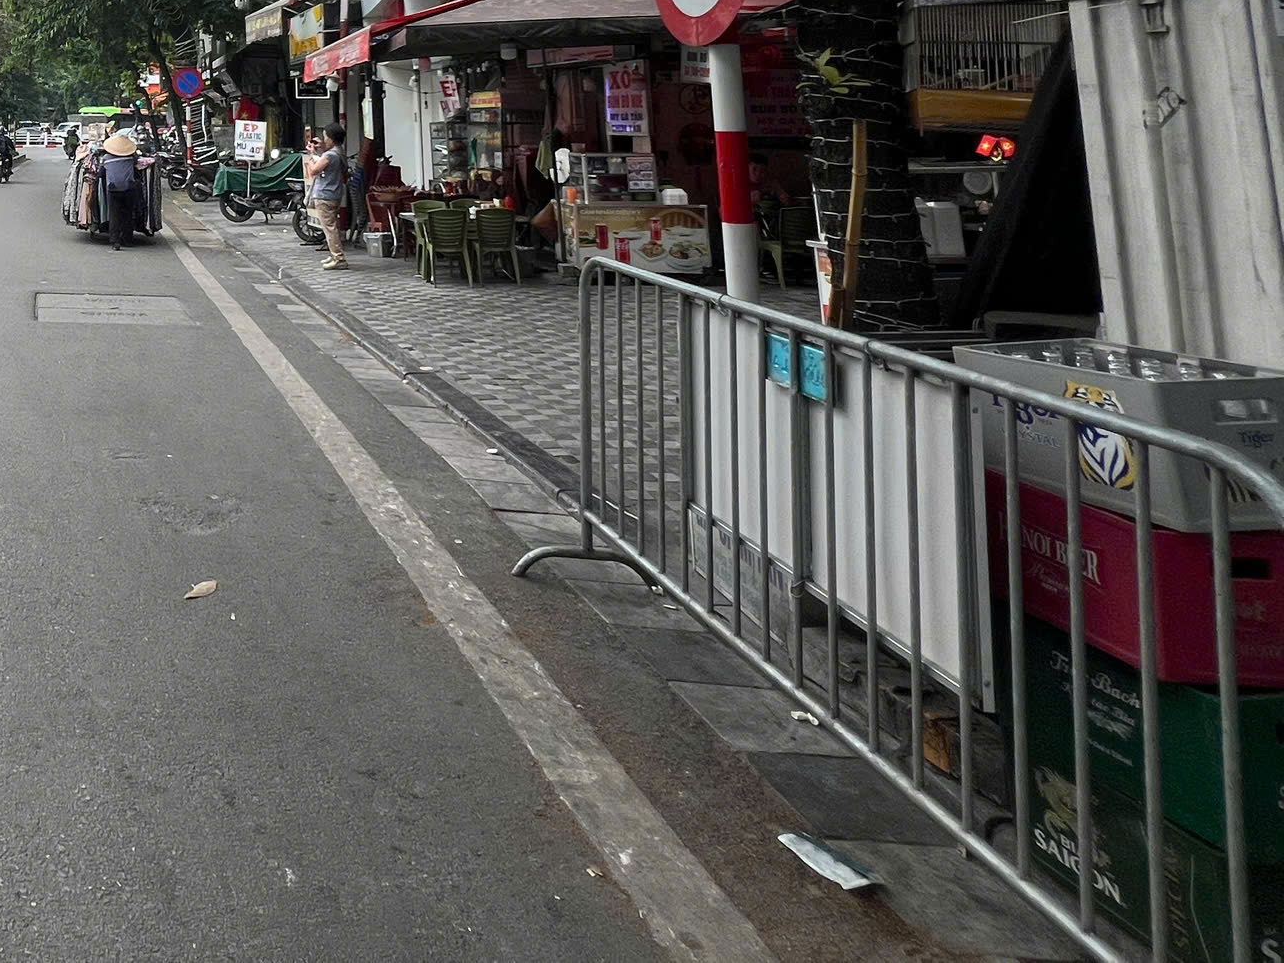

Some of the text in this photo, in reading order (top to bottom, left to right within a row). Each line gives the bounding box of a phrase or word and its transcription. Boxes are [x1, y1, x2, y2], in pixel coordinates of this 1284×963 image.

[238, 131, 263, 141] PLASTIC
[1238, 430, 1275, 449] Tiger
[1055, 540, 1102, 586] BR
